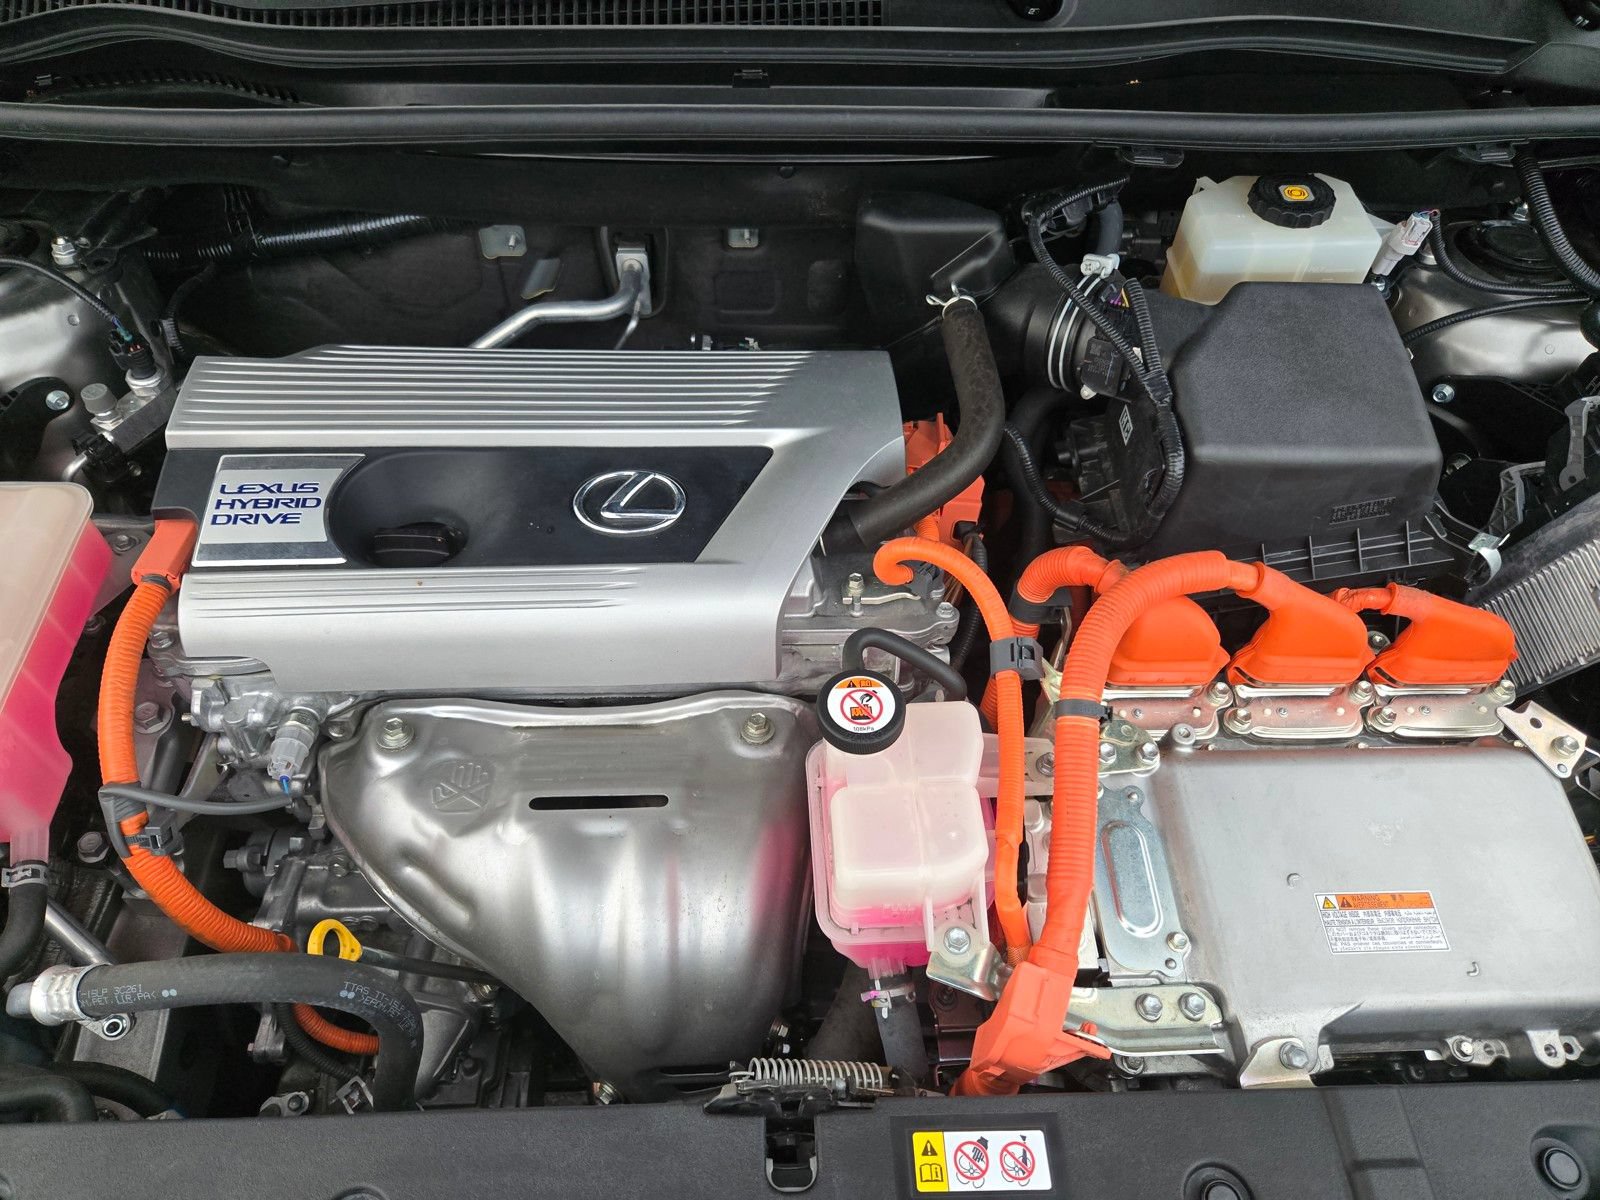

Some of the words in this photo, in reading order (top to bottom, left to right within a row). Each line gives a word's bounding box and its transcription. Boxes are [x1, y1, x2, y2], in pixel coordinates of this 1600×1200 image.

[220, 483, 319, 495] LEXUS
[215, 498, 322, 510] HYBRID
[211, 513, 302, 526] DRIVE
